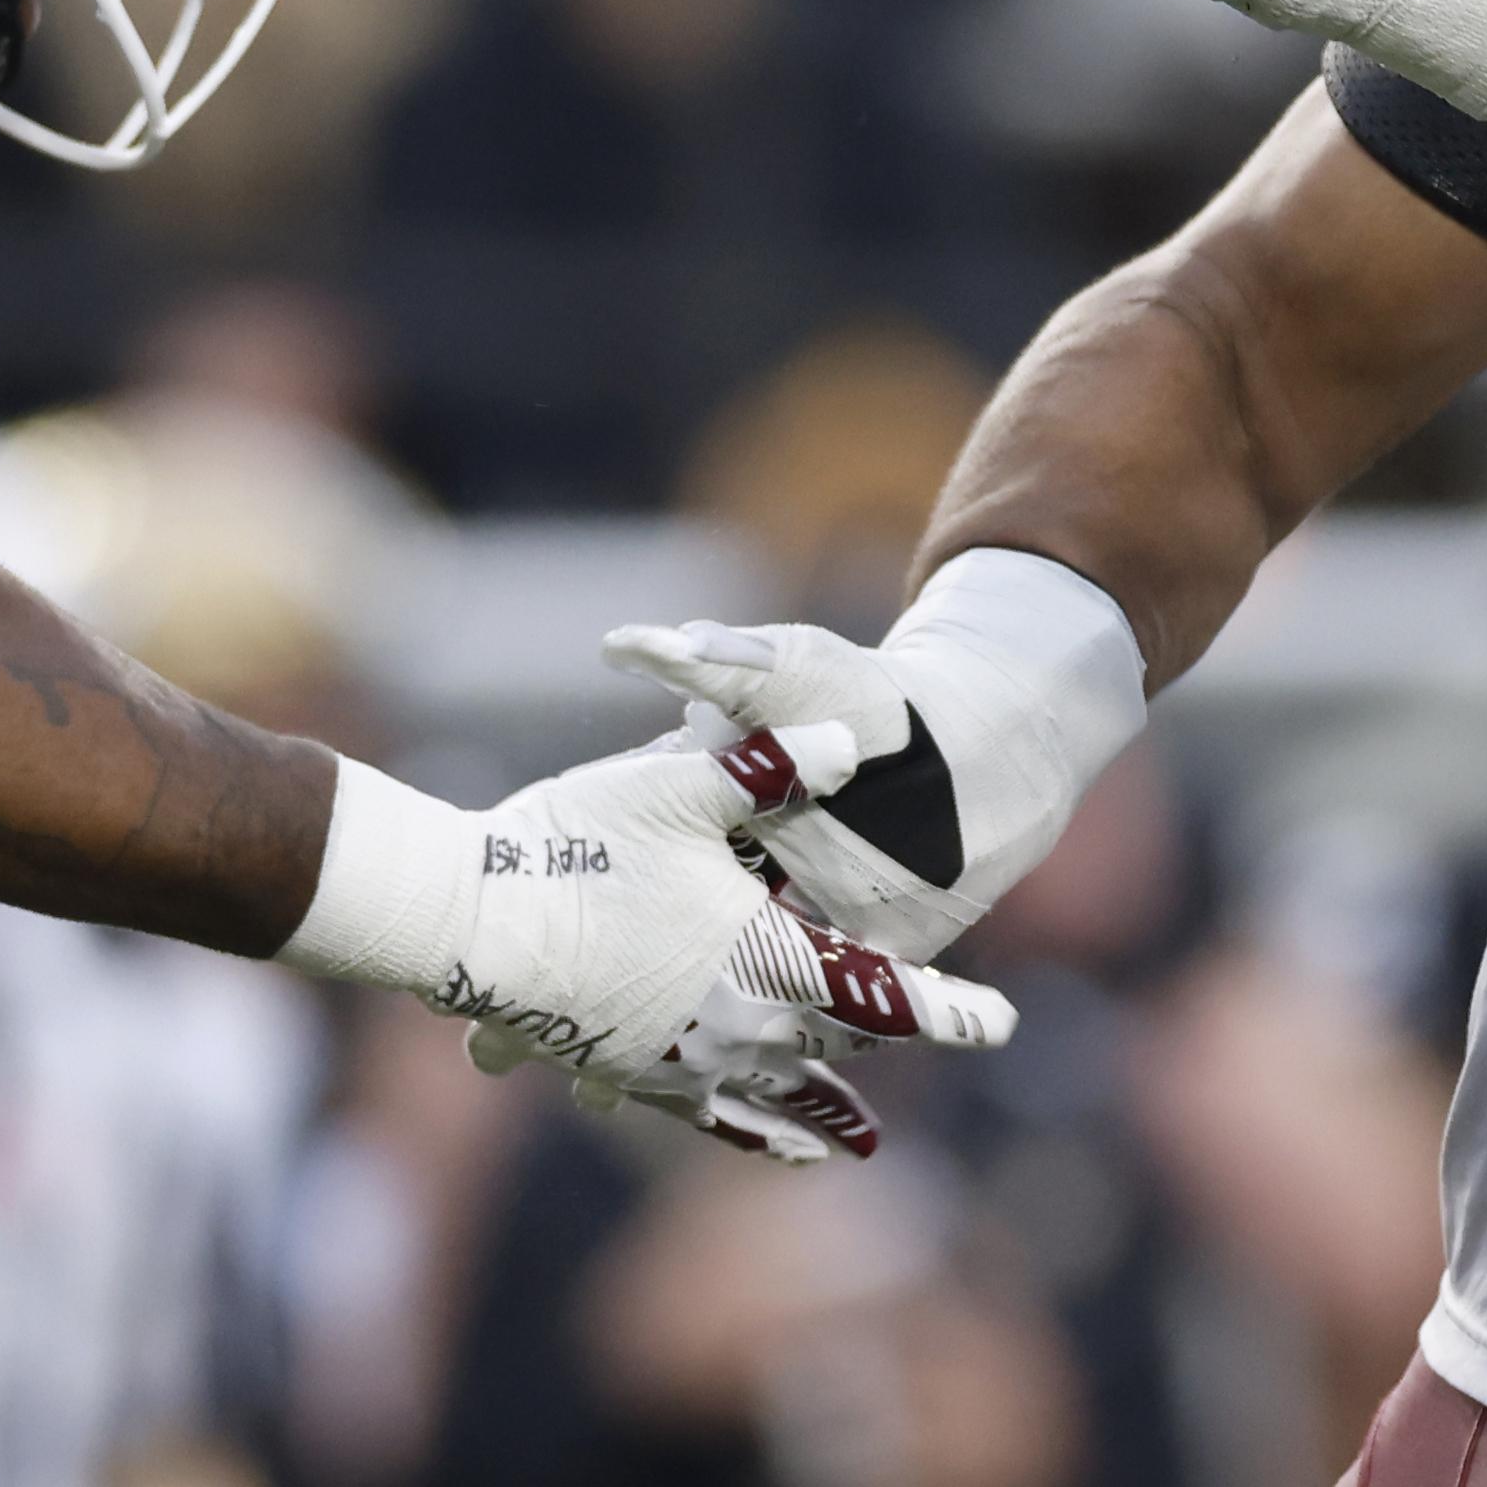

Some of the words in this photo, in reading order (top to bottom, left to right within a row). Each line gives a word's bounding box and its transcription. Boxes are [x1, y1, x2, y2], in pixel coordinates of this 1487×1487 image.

[545, 837, 610, 879] PLAY
[433, 960, 516, 1019] ARE
[505, 1010, 618, 1068] YOU
